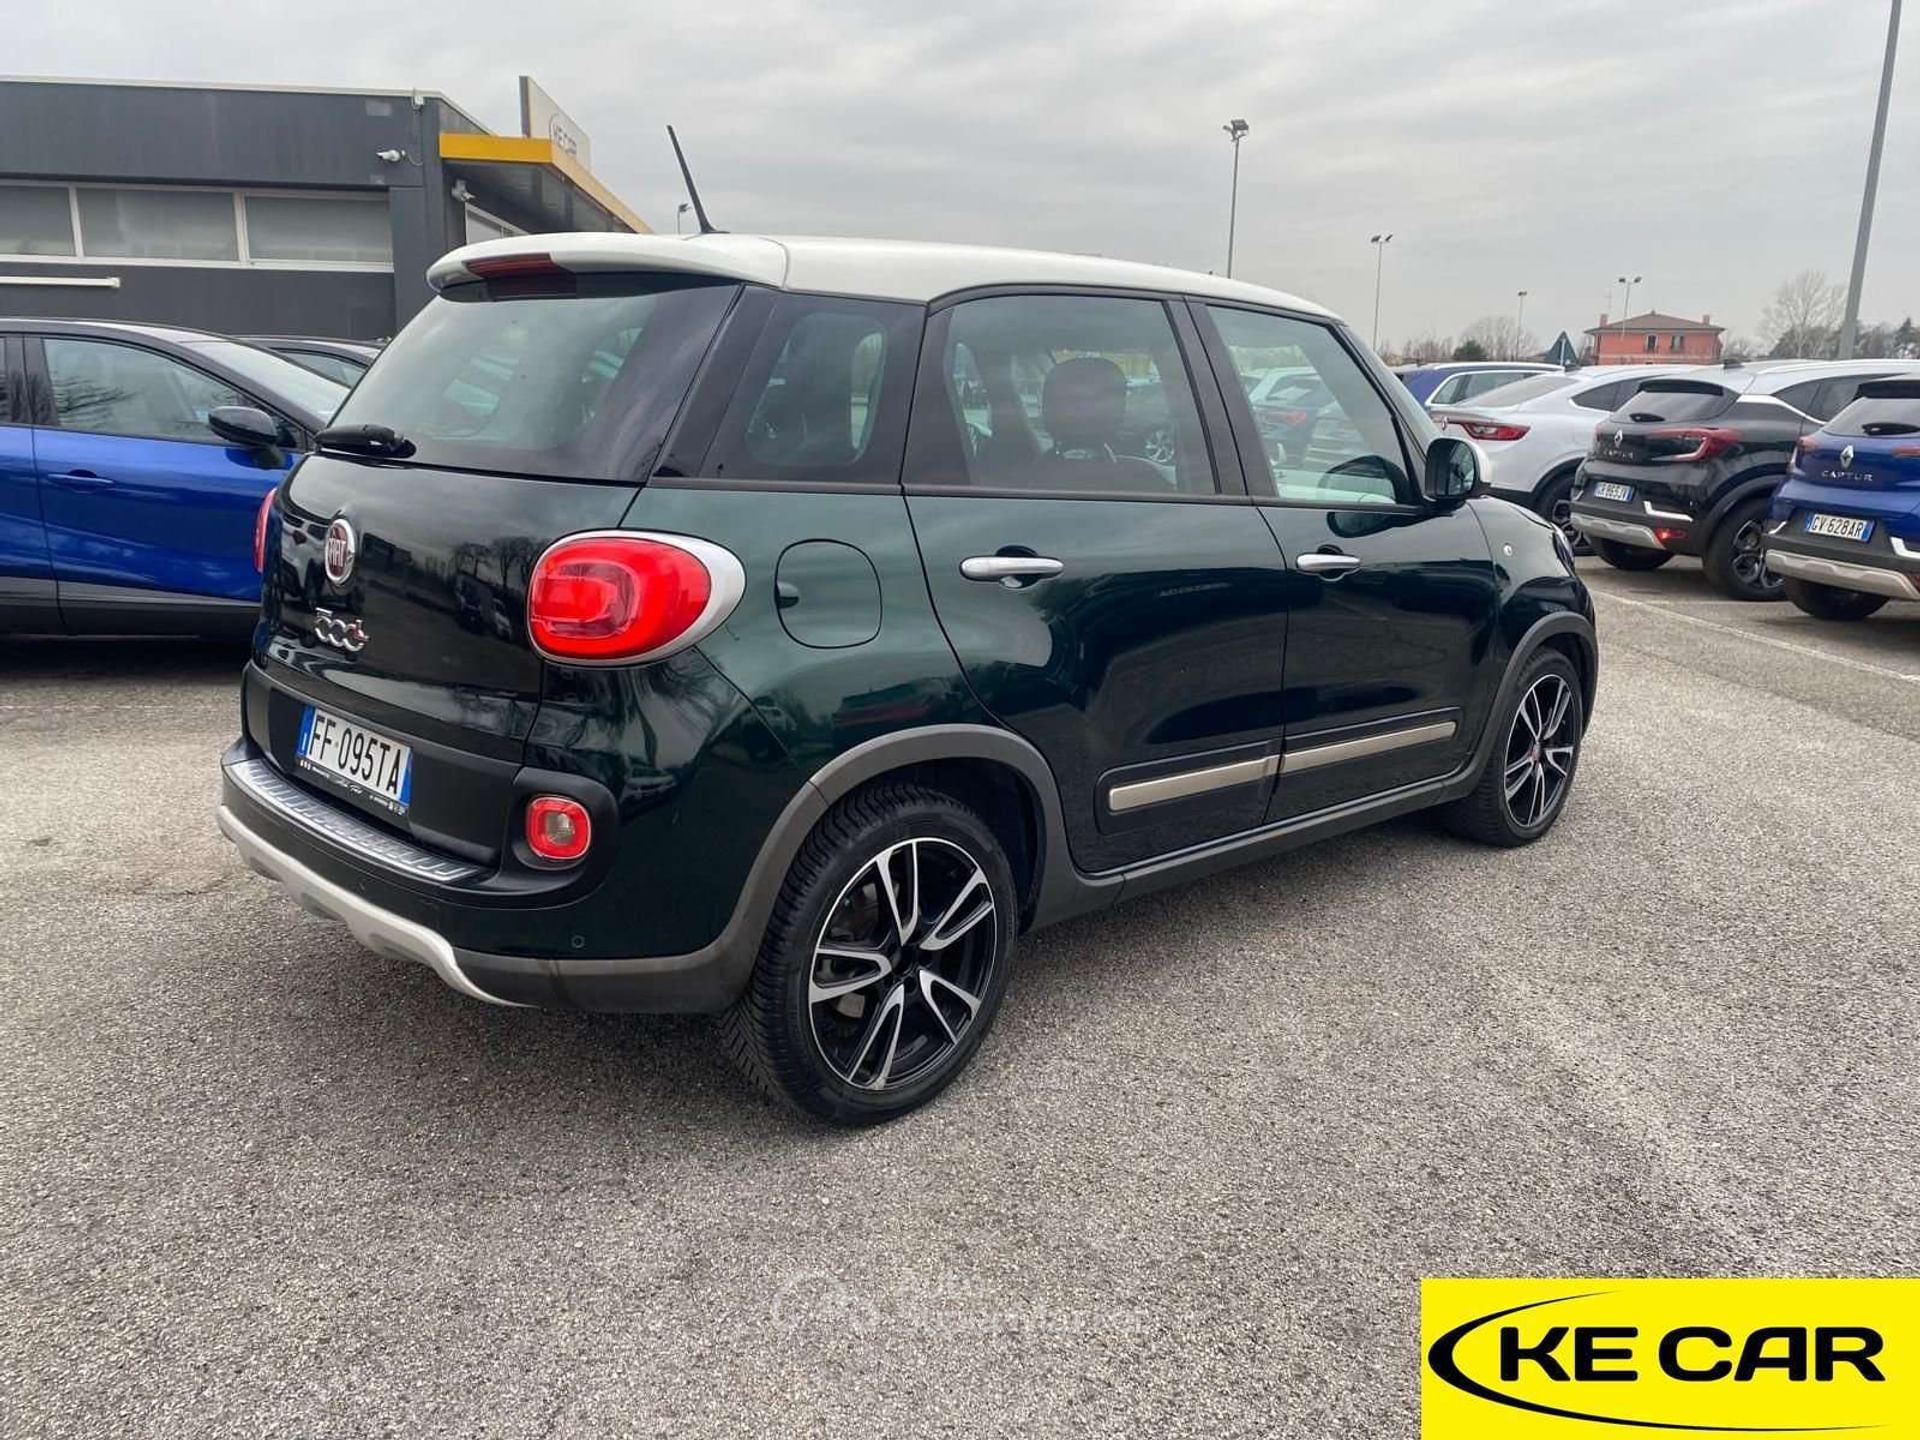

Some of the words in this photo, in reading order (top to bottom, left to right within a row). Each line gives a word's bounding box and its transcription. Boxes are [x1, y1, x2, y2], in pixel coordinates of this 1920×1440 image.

[1822, 470, 1873, 482] CAPTUR
[328, 537, 347, 567] FIAT
[308, 714, 336, 761] FF
[338, 728, 402, 794] 095TA
